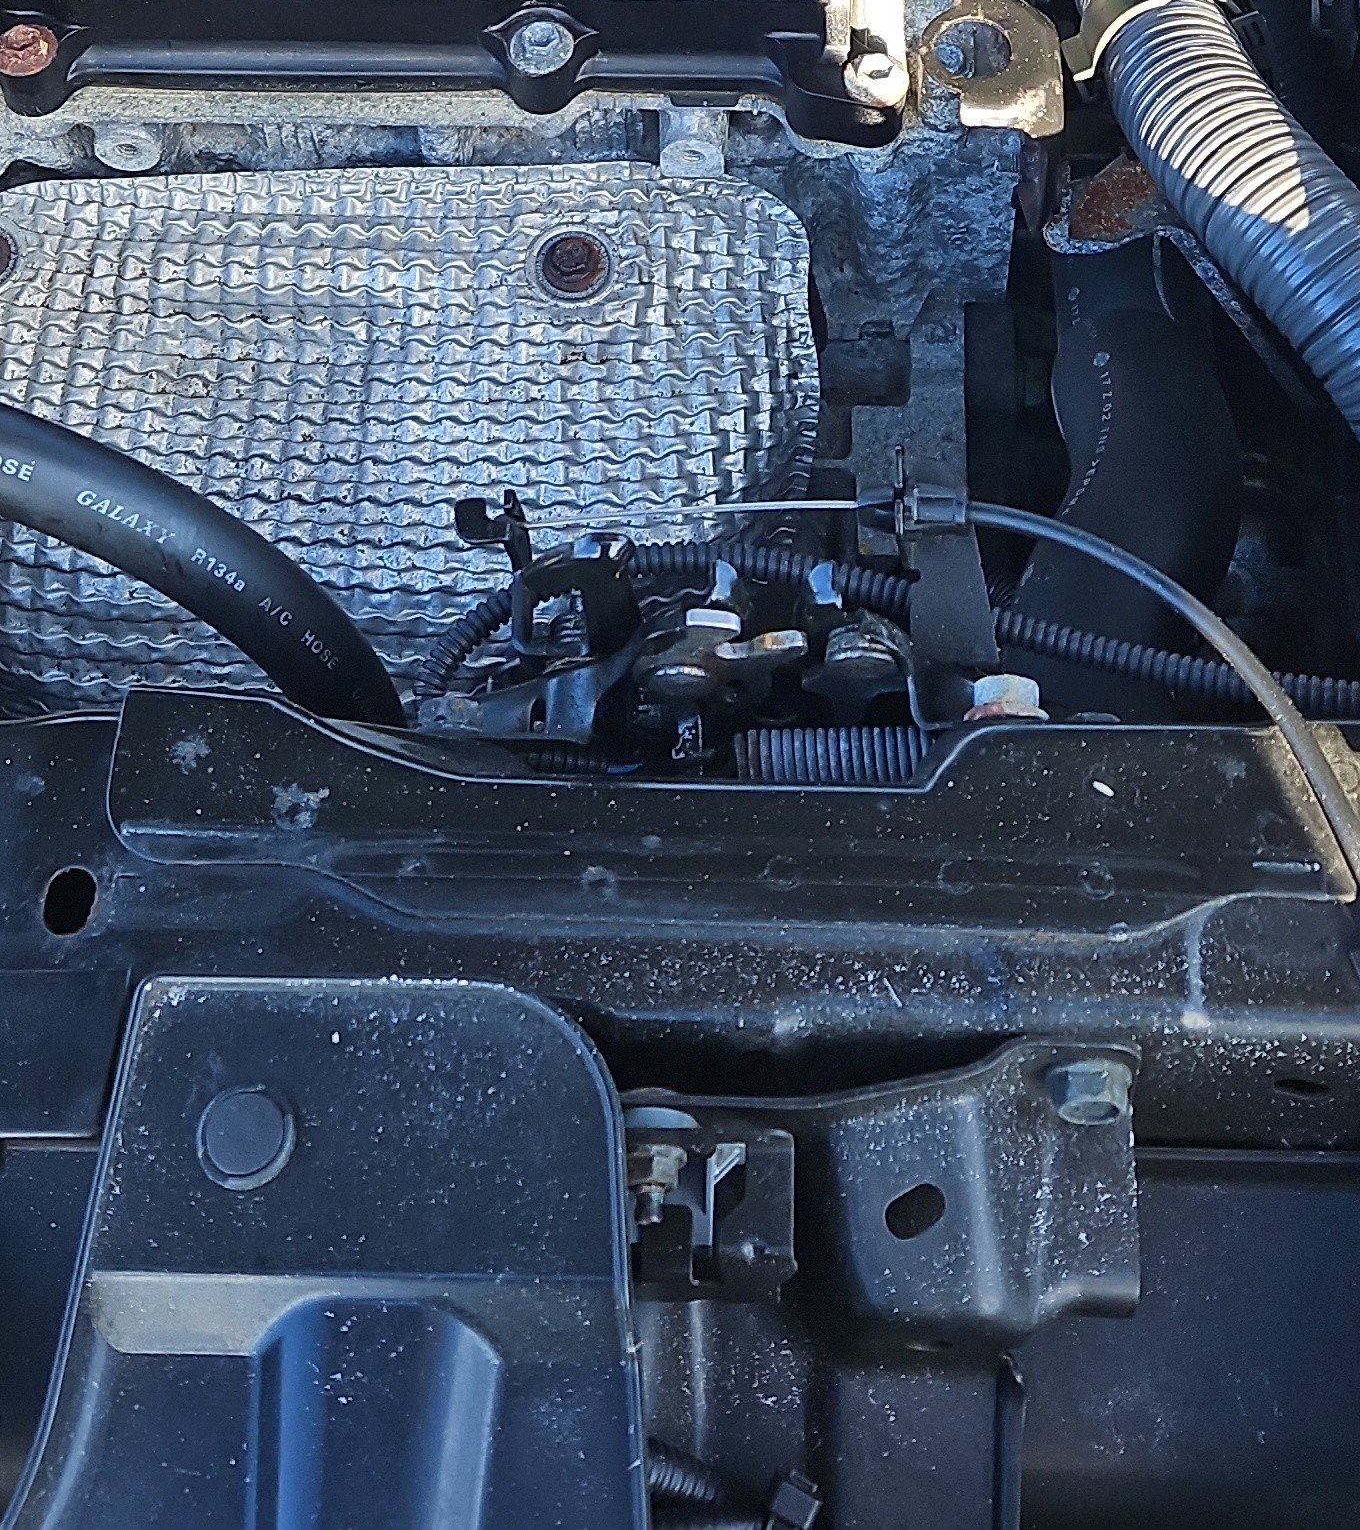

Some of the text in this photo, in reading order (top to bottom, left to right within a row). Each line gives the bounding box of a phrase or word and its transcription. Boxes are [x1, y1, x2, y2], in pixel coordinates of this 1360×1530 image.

[75, 489, 340, 670] GALAXY R134a A/C HOSE
